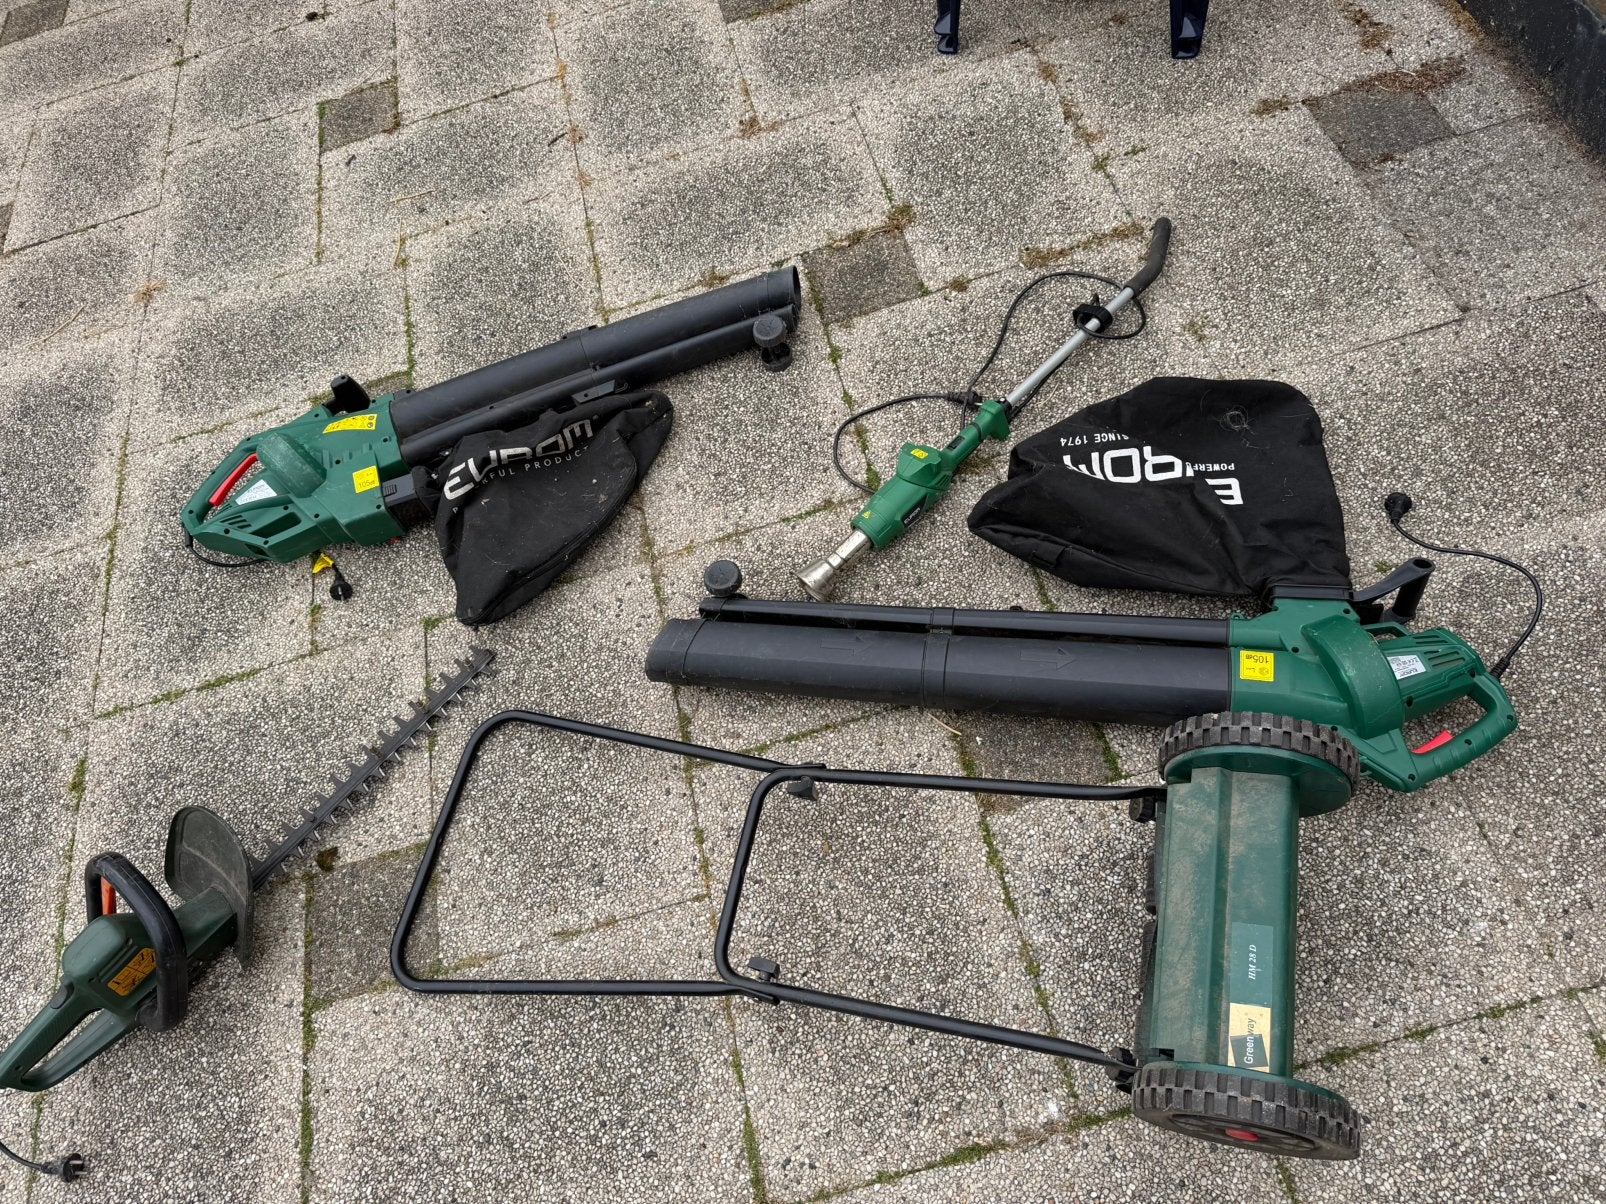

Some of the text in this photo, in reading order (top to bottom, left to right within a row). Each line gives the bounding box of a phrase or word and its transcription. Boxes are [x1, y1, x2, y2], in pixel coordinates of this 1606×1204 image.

[1060, 435, 1088, 447] 1974
[1062, 446, 1243, 505] EROM
[1248, 944, 1257, 980] HM 28 D
[1243, 1017, 1257, 1064] Greenway
